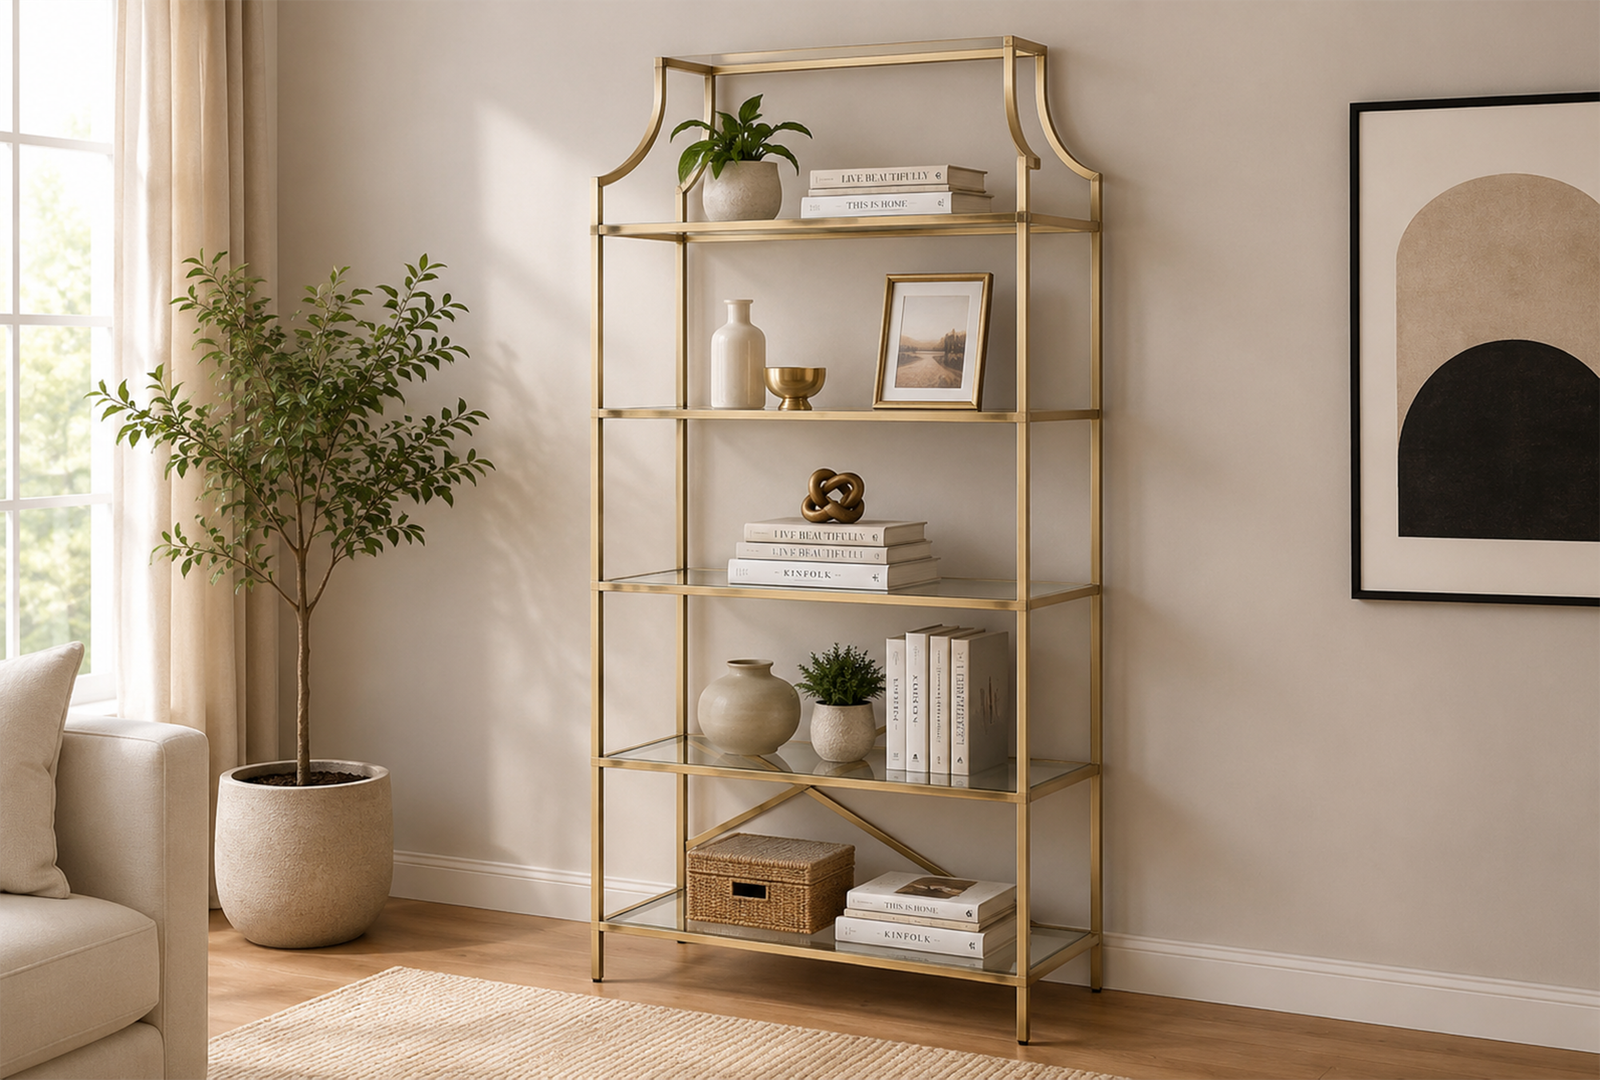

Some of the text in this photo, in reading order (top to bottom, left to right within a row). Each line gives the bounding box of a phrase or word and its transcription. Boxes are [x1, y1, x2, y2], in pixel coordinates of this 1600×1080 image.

[865, 171, 930, 182] BEAUTIFULLY
[846, 200, 908, 210] THIS IS HOME
[783, 570, 832, 579] KINFOLK
[884, 902, 903, 910] THIS
[884, 930, 931, 943] KINFOLK
